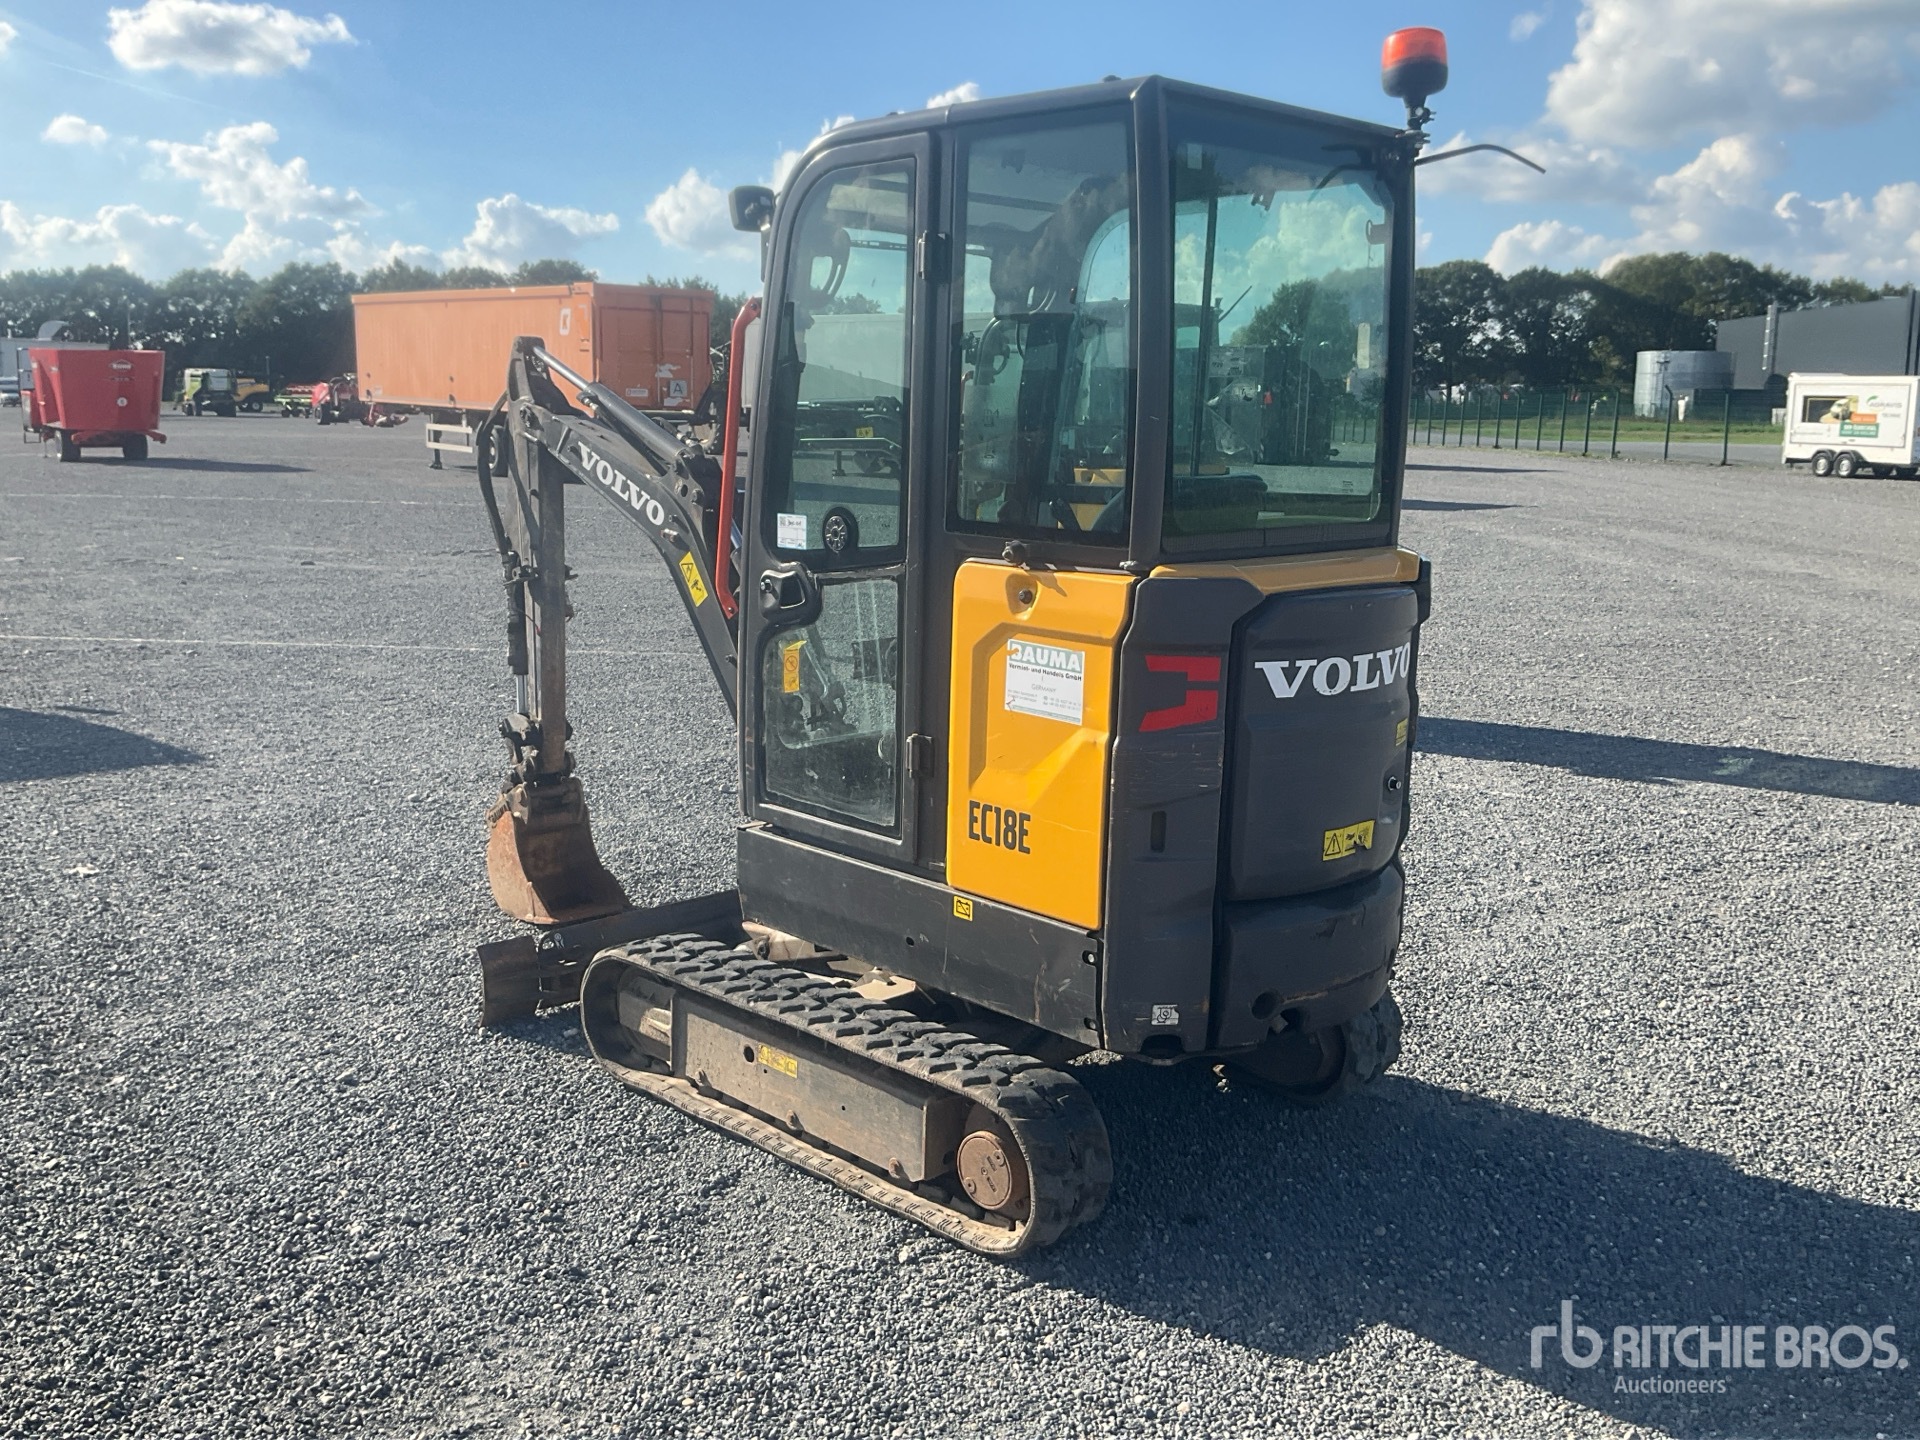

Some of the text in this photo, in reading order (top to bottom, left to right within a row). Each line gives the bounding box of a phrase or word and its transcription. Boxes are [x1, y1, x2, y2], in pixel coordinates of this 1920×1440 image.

[672, 383, 684, 395] A
[578, 441, 665, 526] VOLVO
[1254, 641, 1411, 698] VOLVO
[968, 800, 1031, 854] EC18E
